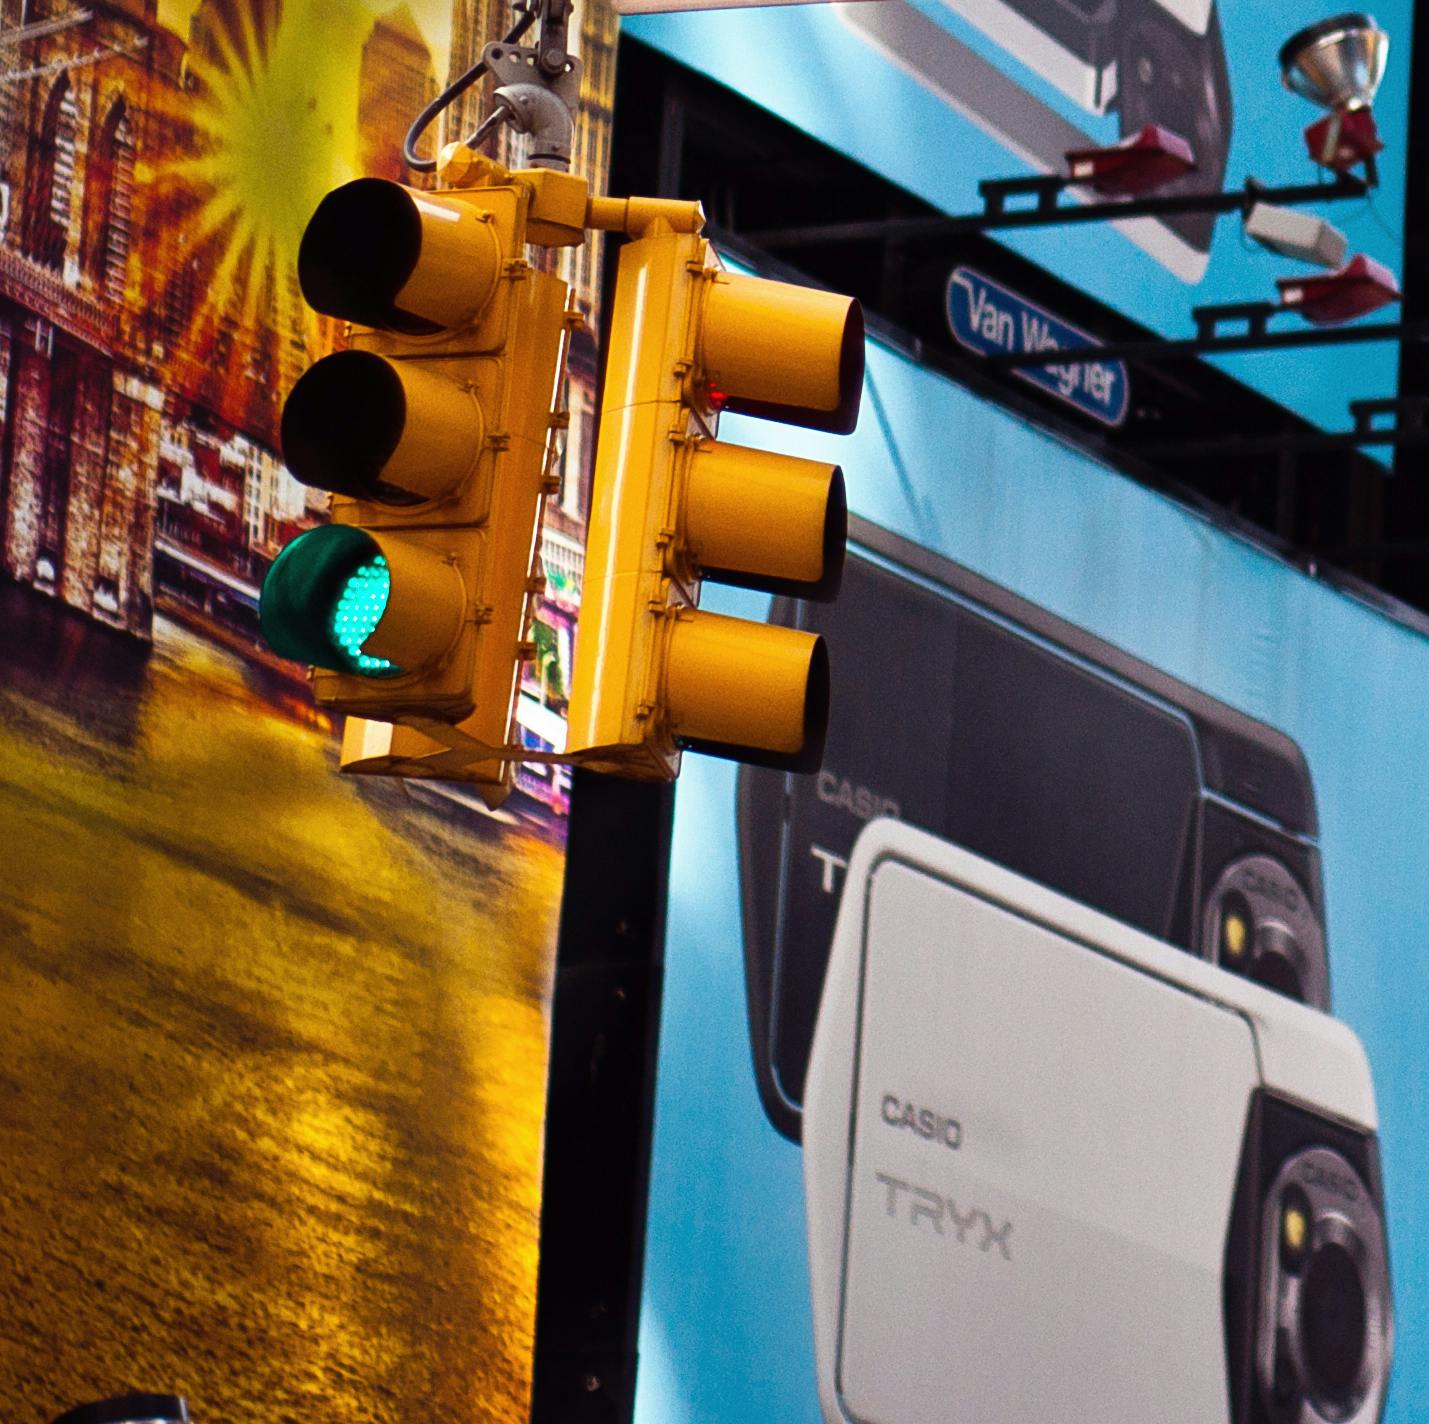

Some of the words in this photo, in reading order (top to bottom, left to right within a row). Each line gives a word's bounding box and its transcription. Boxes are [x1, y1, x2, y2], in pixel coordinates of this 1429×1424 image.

[960, 280, 1014, 352] Van
[881, 1094, 963, 1150] CASIO
[875, 1170, 1013, 1262] TRYX
